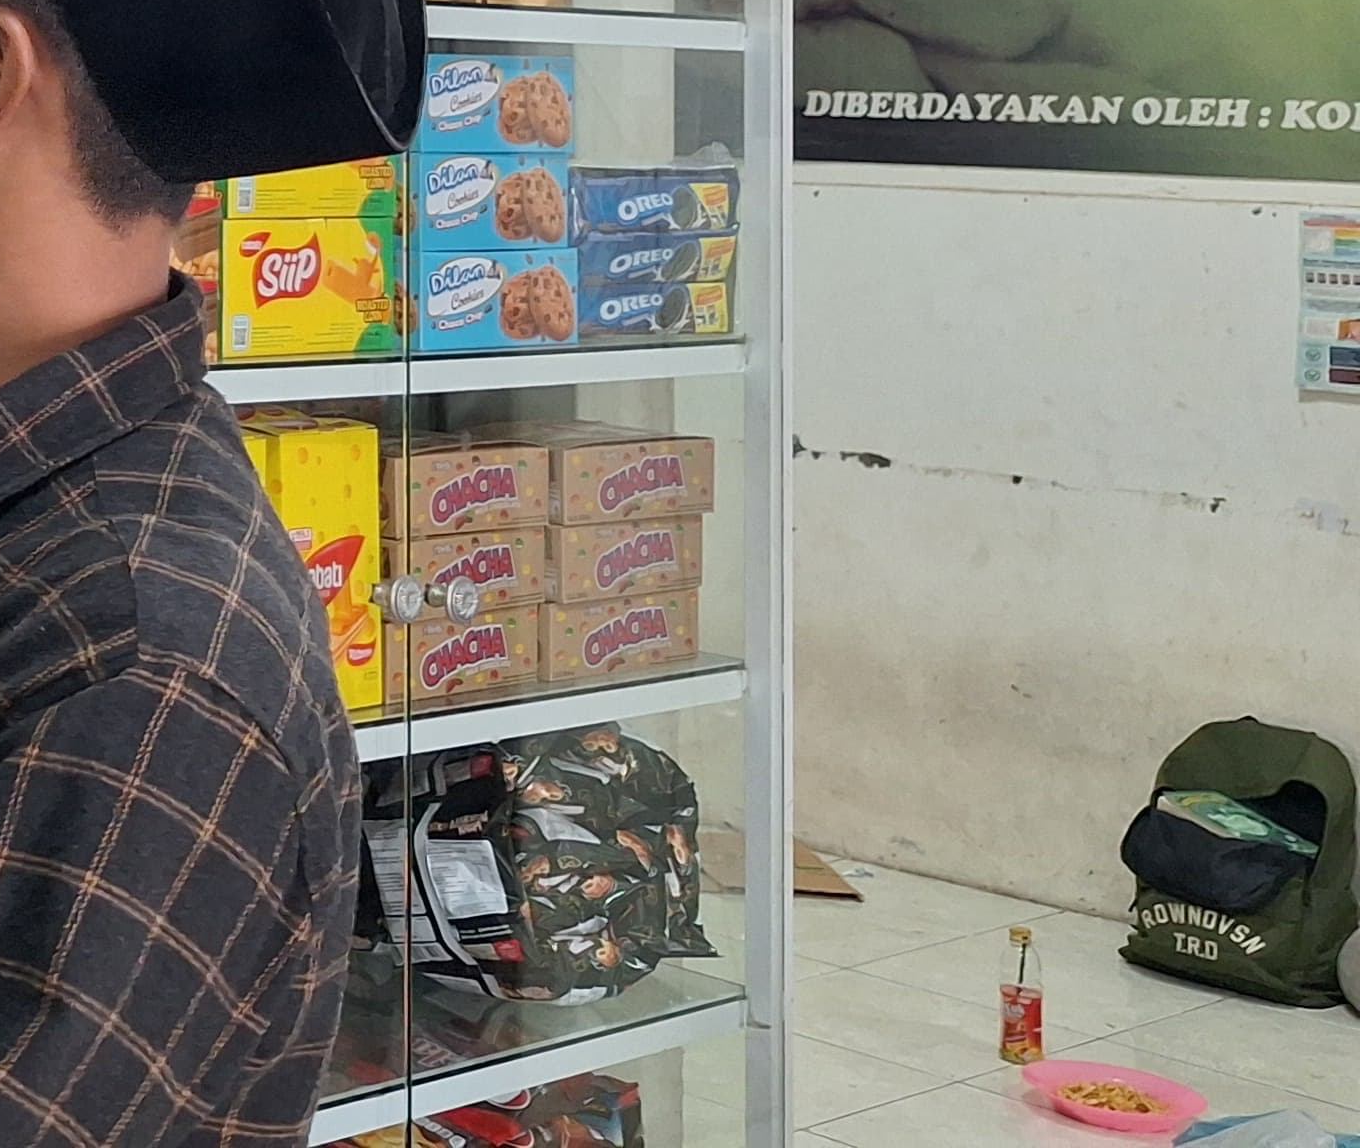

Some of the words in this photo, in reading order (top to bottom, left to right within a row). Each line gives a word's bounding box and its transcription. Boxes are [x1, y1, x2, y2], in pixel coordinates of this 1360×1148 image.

[431, 67, 483, 97] Dilan
[803, 89, 1124, 126] DIBERDAYAKAN
[1131, 98, 1251, 128] OLEH
[428, 163, 479, 194] Dilan
[618, 193, 674, 221] OREO
[609, 248, 674, 274] OREO
[430, 263, 485, 295] Dilan
[599, 293, 664, 321] OREO
[310, 560, 344, 590] abati
